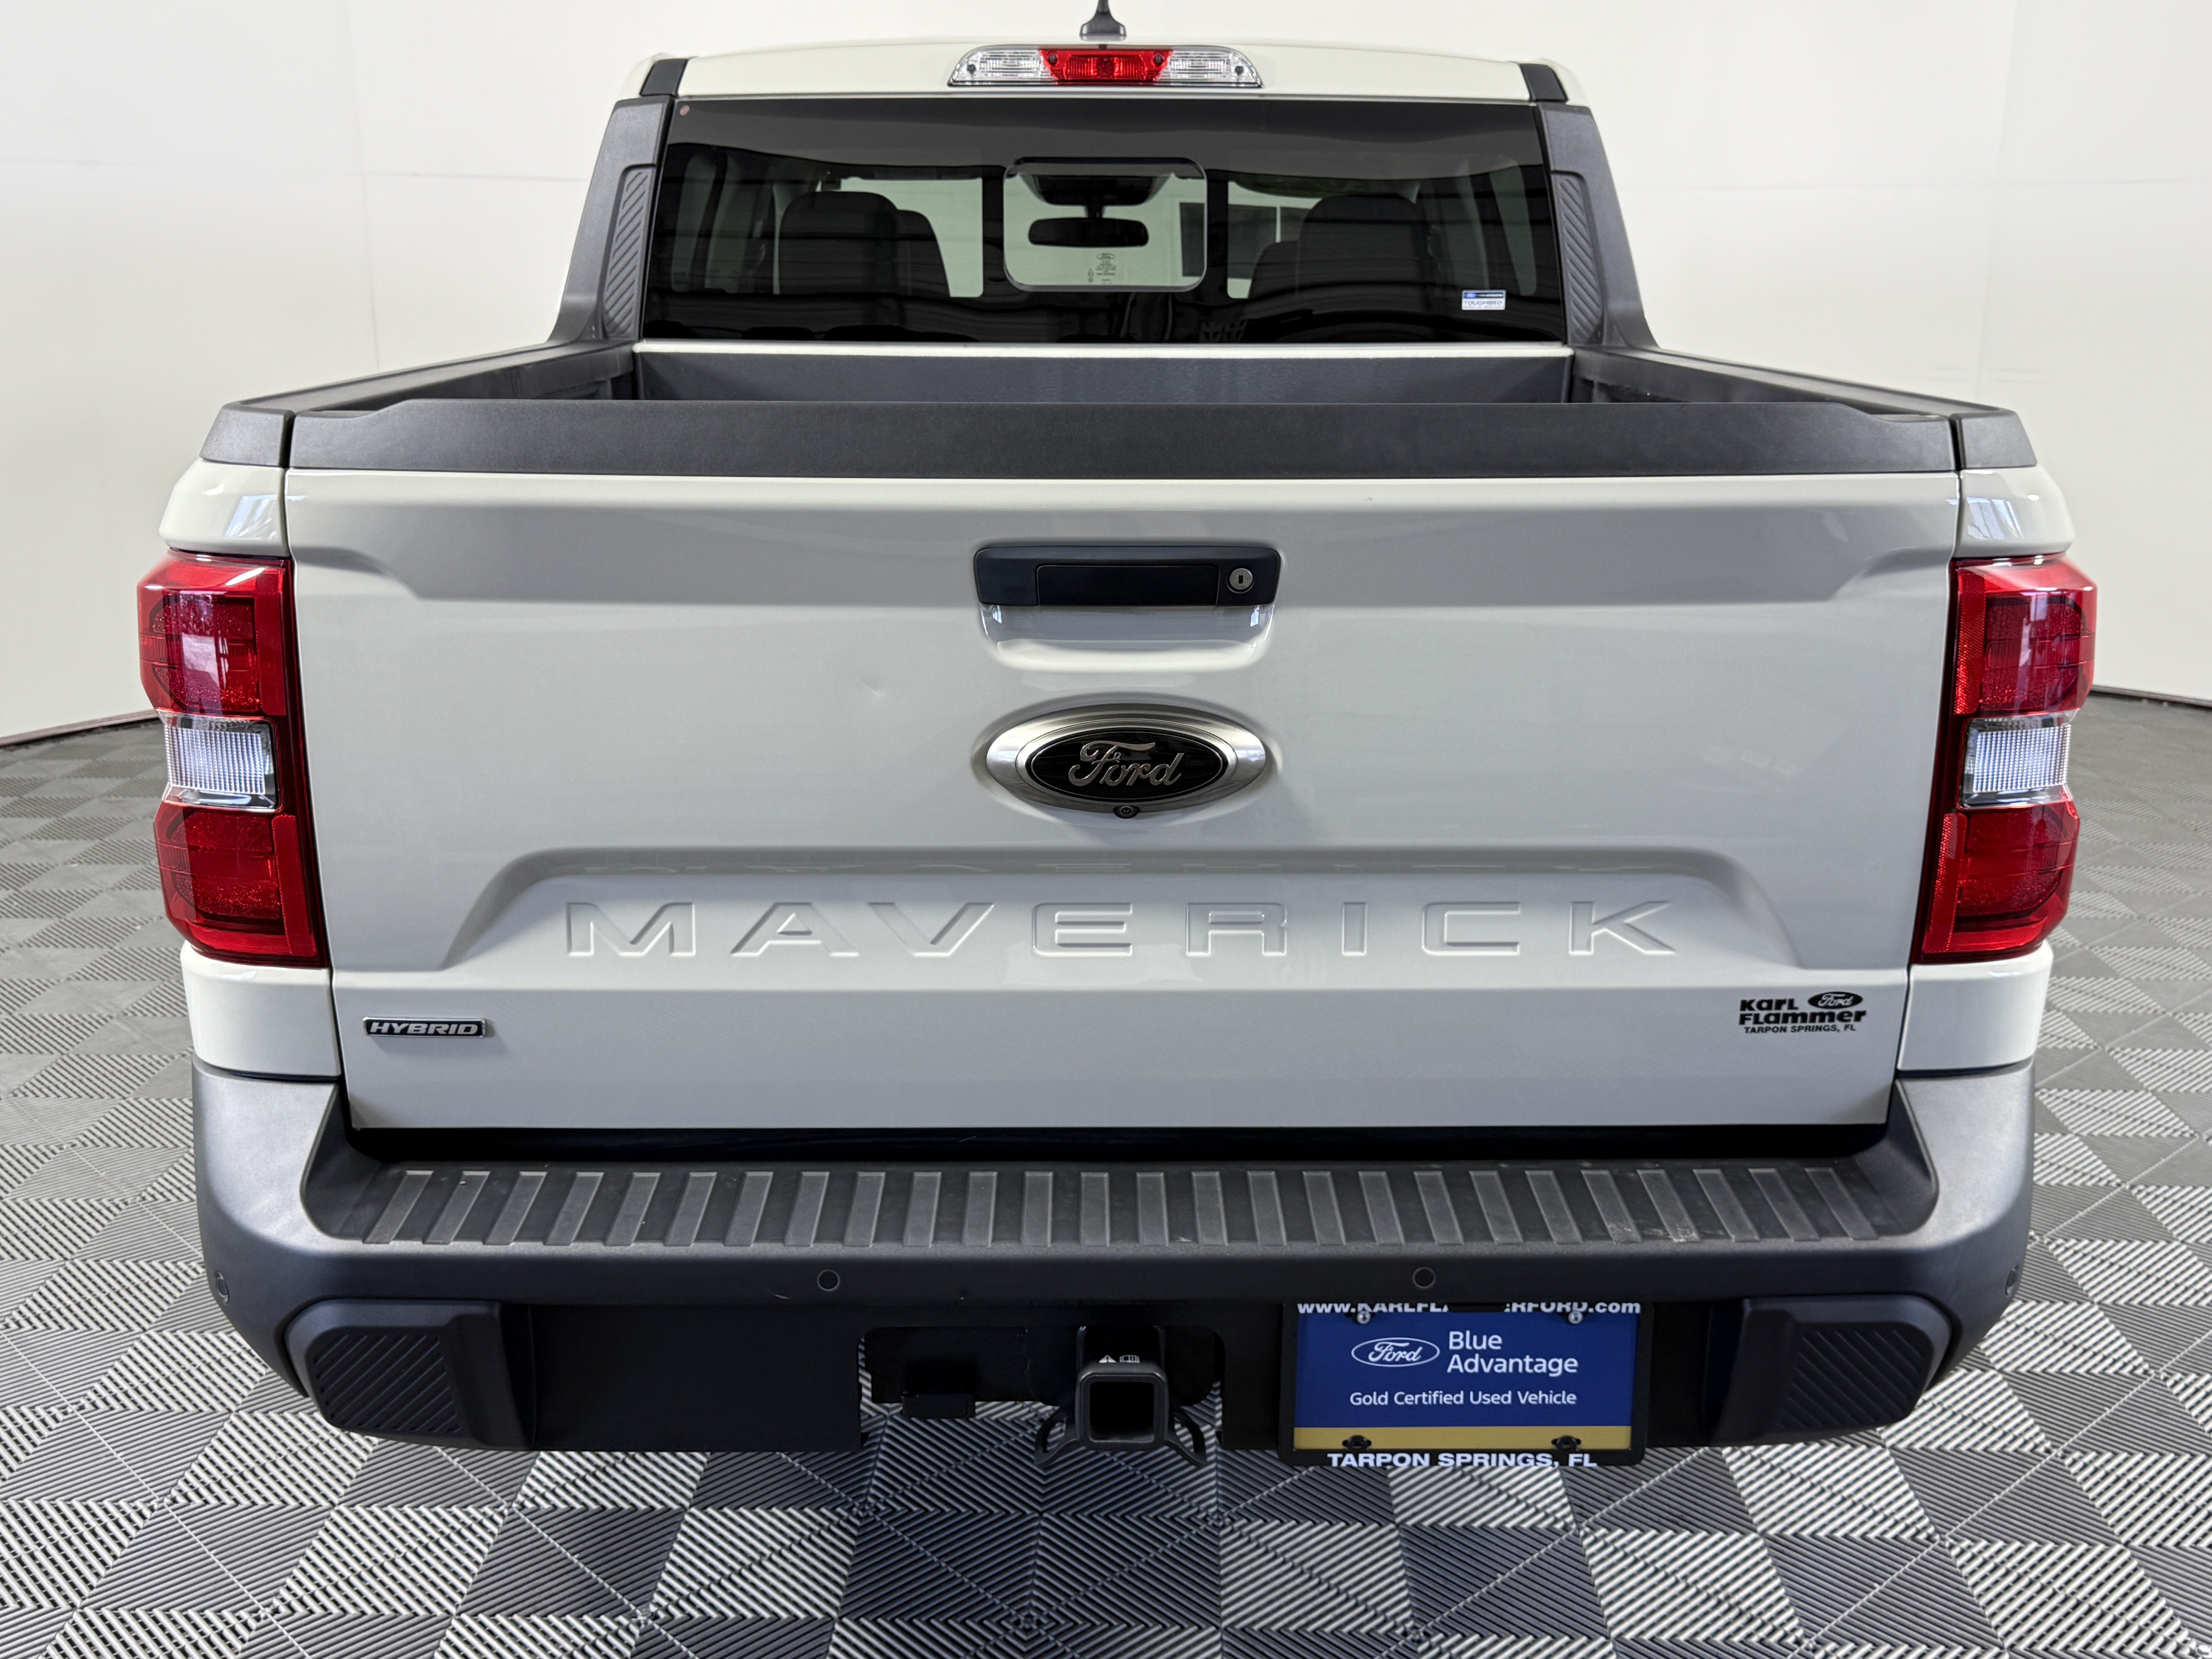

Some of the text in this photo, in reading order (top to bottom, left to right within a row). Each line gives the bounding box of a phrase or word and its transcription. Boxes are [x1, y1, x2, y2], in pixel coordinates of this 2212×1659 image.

[1068, 740, 1185, 787] Ford
[566, 901, 1677, 957] MAVERICK
[1818, 993, 1853, 1006] Ford
[370, 1022, 478, 1035] HYBRID
[1791, 1024, 1840, 1032] SPRINGS,
[1449, 1331, 1503, 1350] Blue
[1368, 1341, 1422, 1362] Ford
[1447, 1354, 1578, 1377] Advantage
[1350, 1390, 1577, 1405] Gold Certified Used Vehicle
[1327, 1453, 1597, 1467] TARPON SPRINGS, FL
